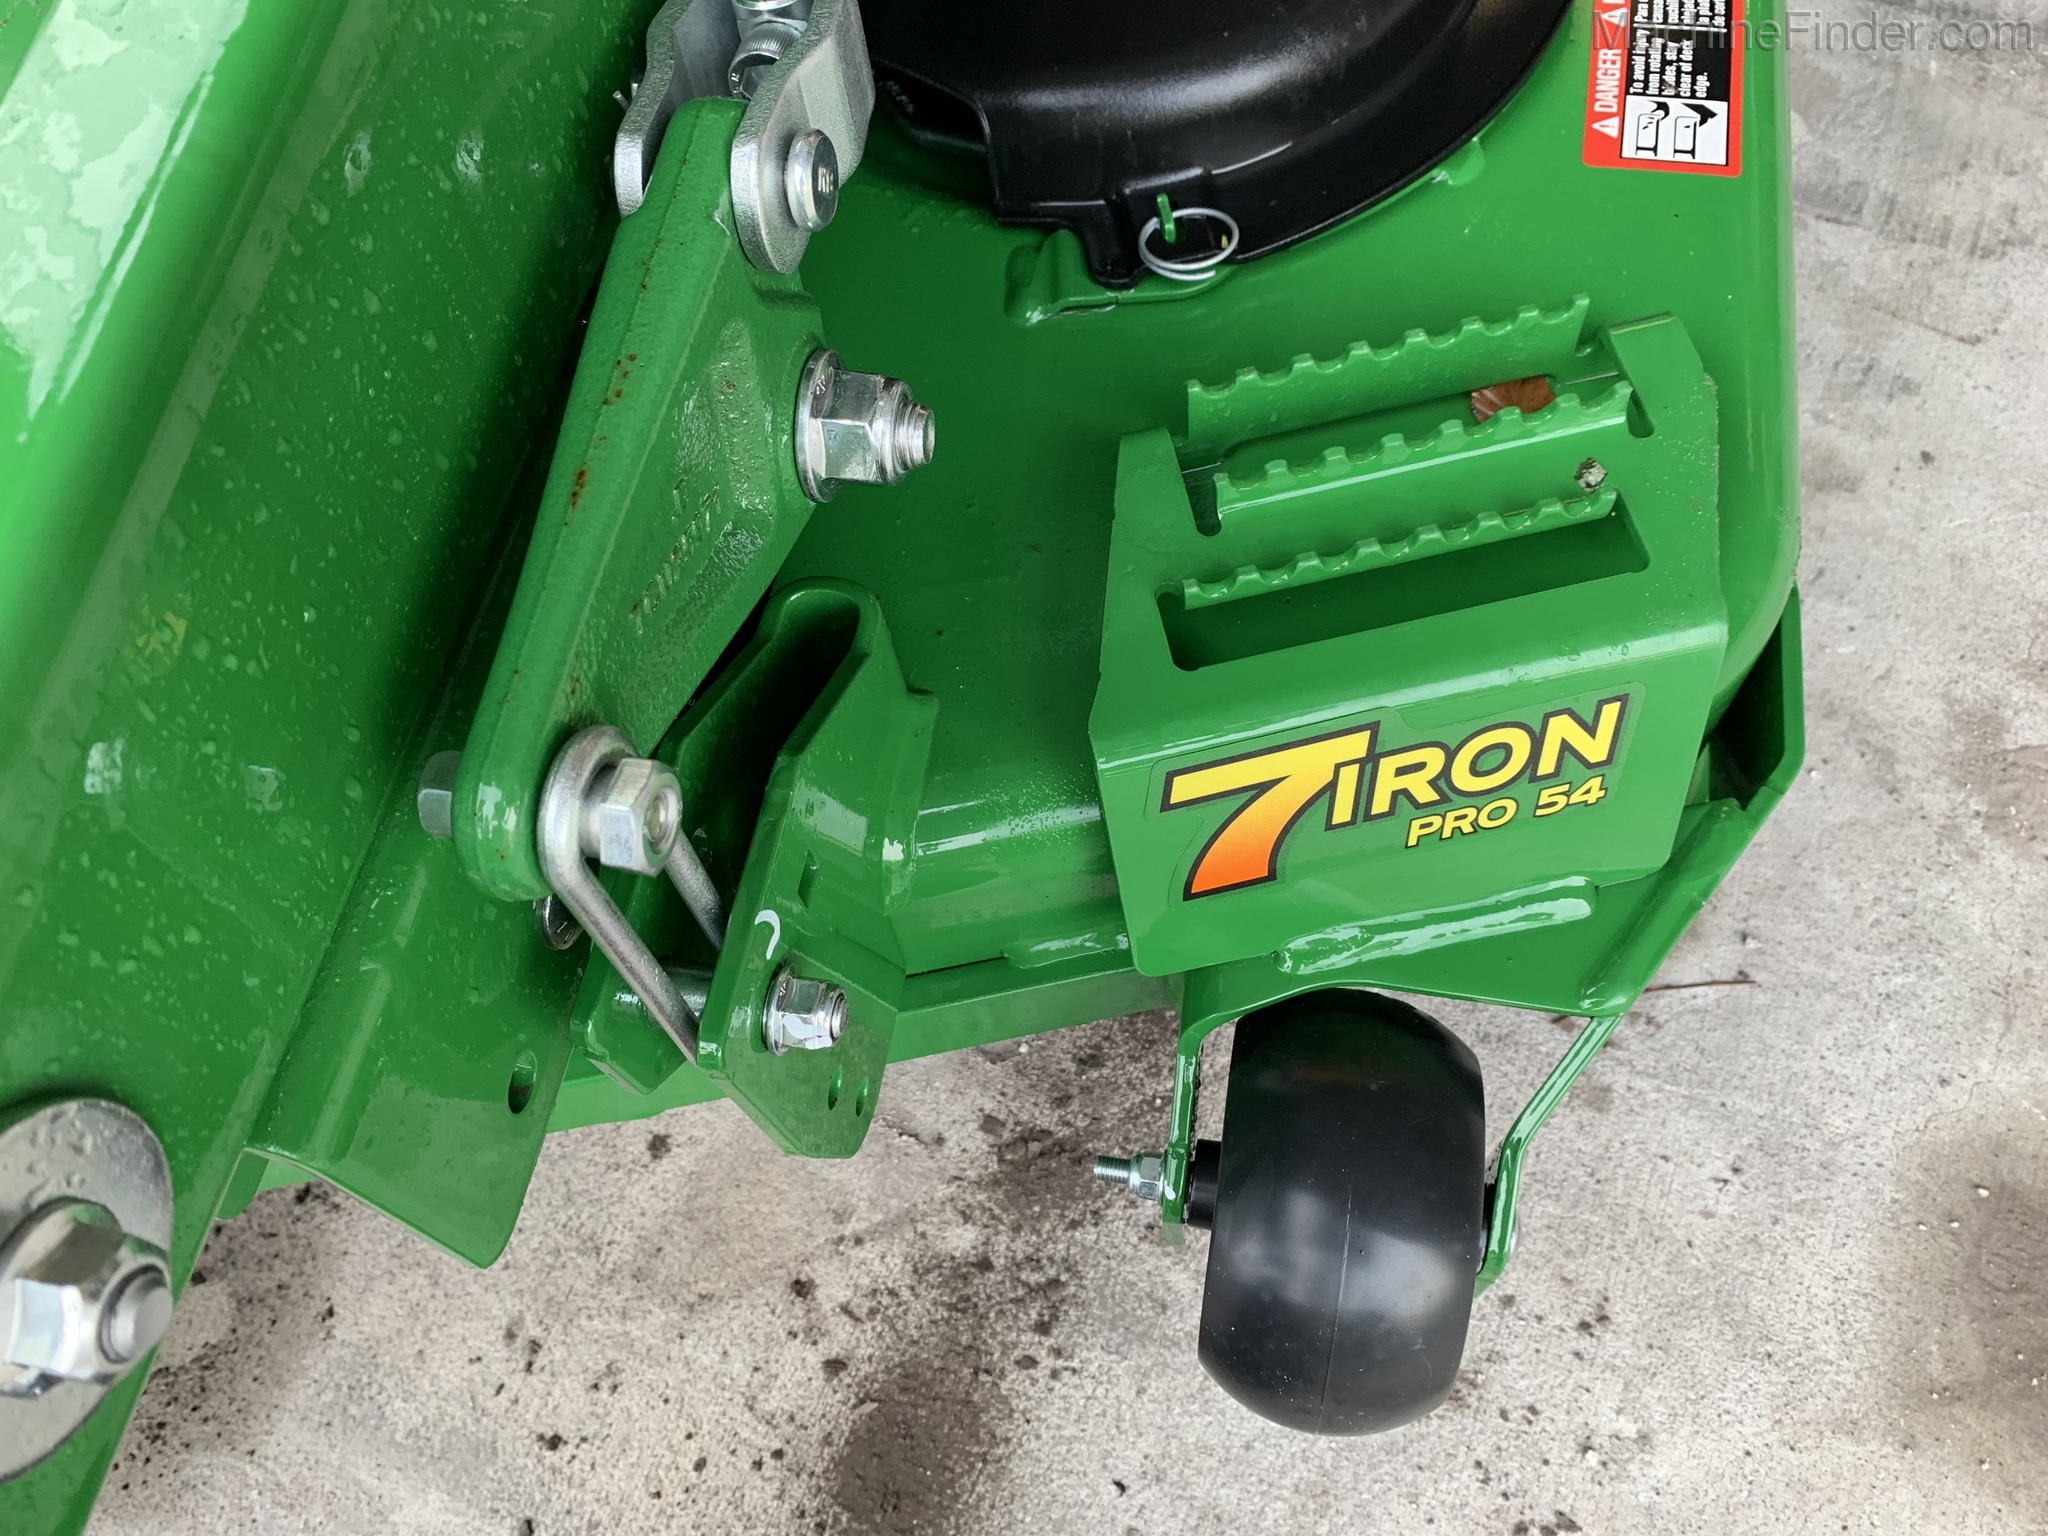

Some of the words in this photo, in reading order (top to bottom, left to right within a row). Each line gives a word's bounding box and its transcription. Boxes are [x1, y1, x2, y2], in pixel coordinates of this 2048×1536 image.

[1633, 3, 1648, 22] Para
[1712, 15, 1726, 27] de
[1632, 29, 1650, 54] injury
[1664, 42, 1681, 61] stay
[1679, 39, 1694, 61] deck
[1648, 38, 1665, 72] rotating
[1632, 56, 1646, 81] avoid
[1678, 62, 1693, 73] of
[1594, 48, 1622, 113] DANGER
[1629, 83, 1644, 95] To
[1646, 74, 1660, 95] from
[1661, 63, 1678, 96] bdes,
[1678, 74, 1692, 97] clear
[1693, 72, 1711, 98] edge.
[1405, 798, 1518, 849] PRO
[1533, 775, 1609, 818] 54
